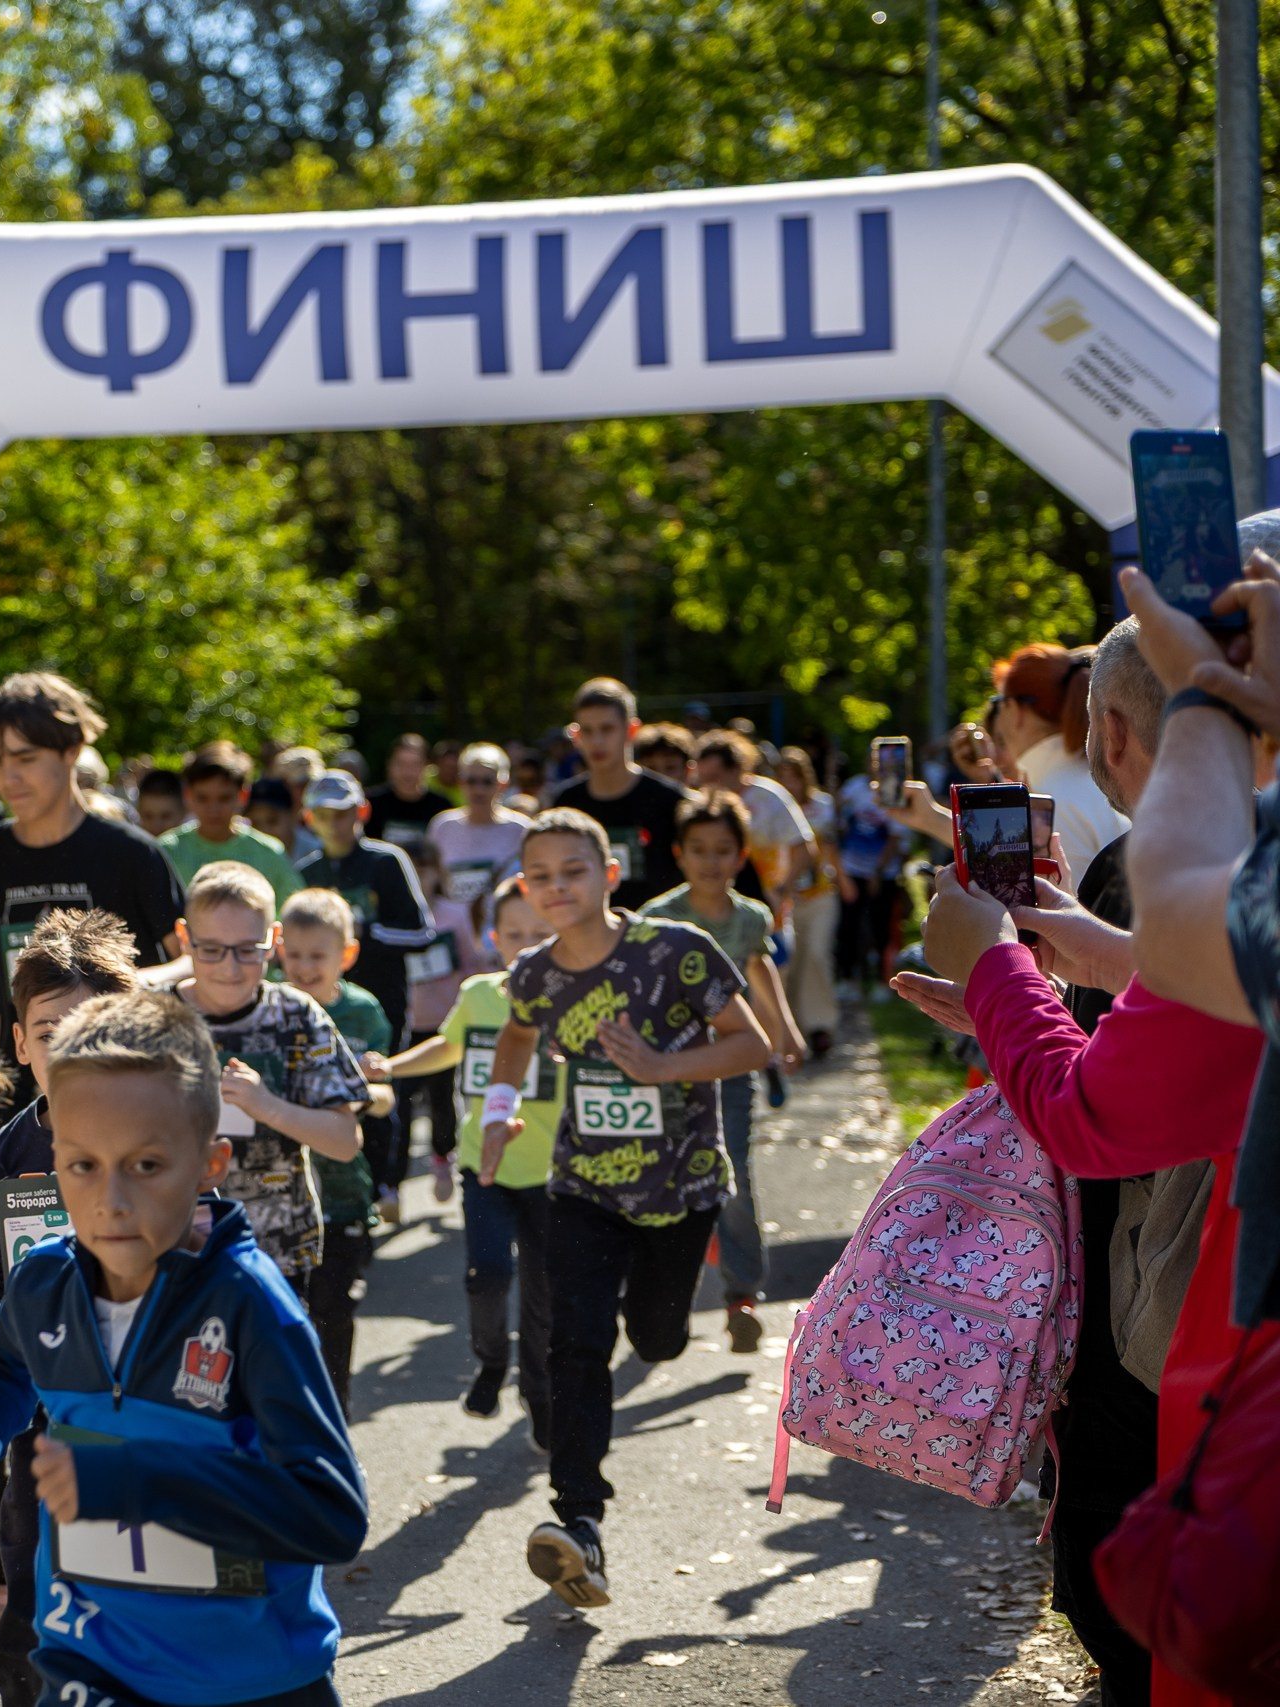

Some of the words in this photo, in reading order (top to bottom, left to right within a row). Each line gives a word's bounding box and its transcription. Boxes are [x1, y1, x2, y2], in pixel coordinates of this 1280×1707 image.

[39, 208, 894, 393] ФИНИШ
[584, 1100, 655, 1129] 592
[6, 1193, 16, 1209] 5
[16, 1196, 58, 1209] городов
[47, 1214, 53, 1222] 5
[117, 1522, 146, 1573] 1
[44, 1582, 101, 1640] 27
